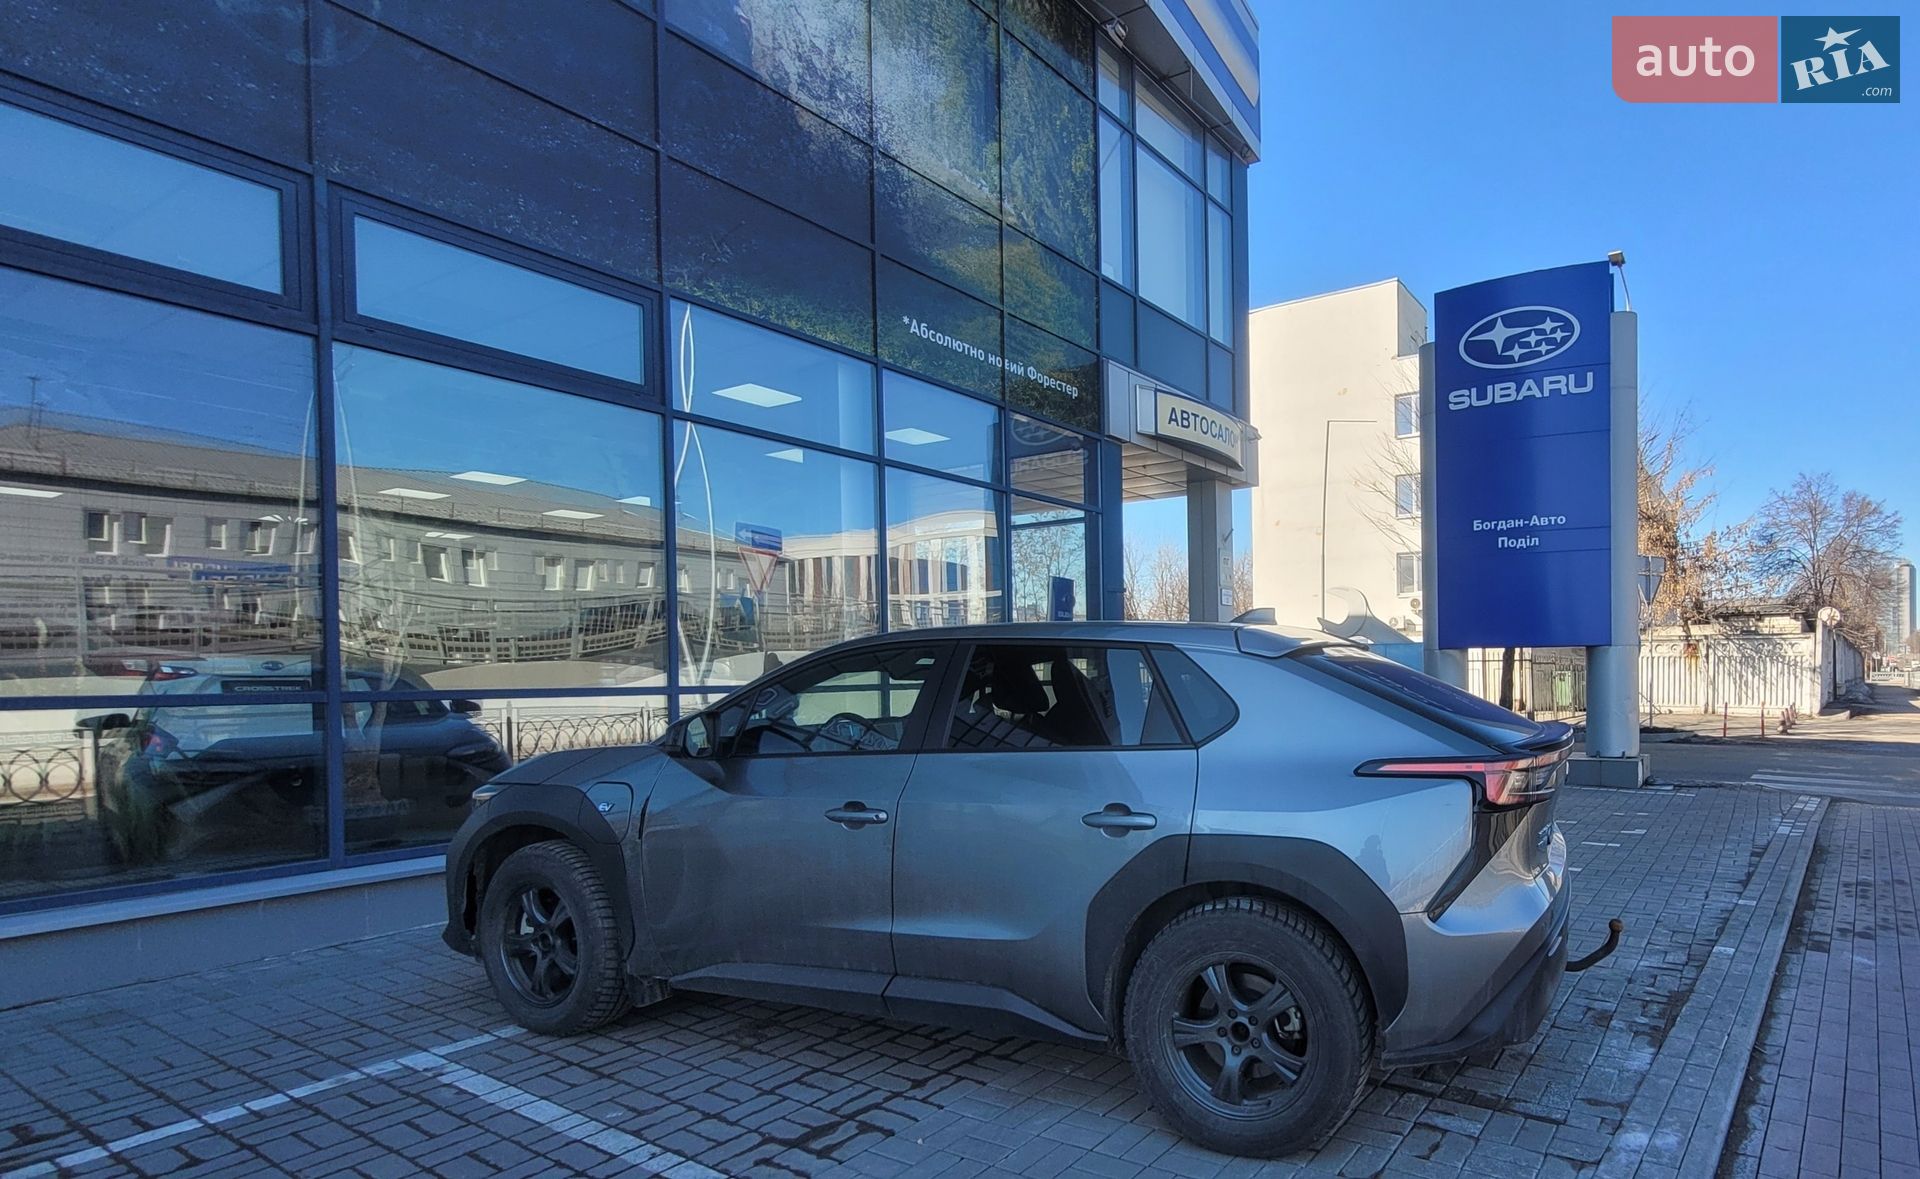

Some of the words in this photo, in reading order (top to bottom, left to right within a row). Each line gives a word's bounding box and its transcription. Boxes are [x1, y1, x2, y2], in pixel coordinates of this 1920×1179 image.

[1027, 365, 1079, 400] Форестер
[1448, 371, 1594, 411] SUBARU
[1473, 514, 1566, 532] Богдан-Авто
[1497, 535, 1540, 549] Поділ
